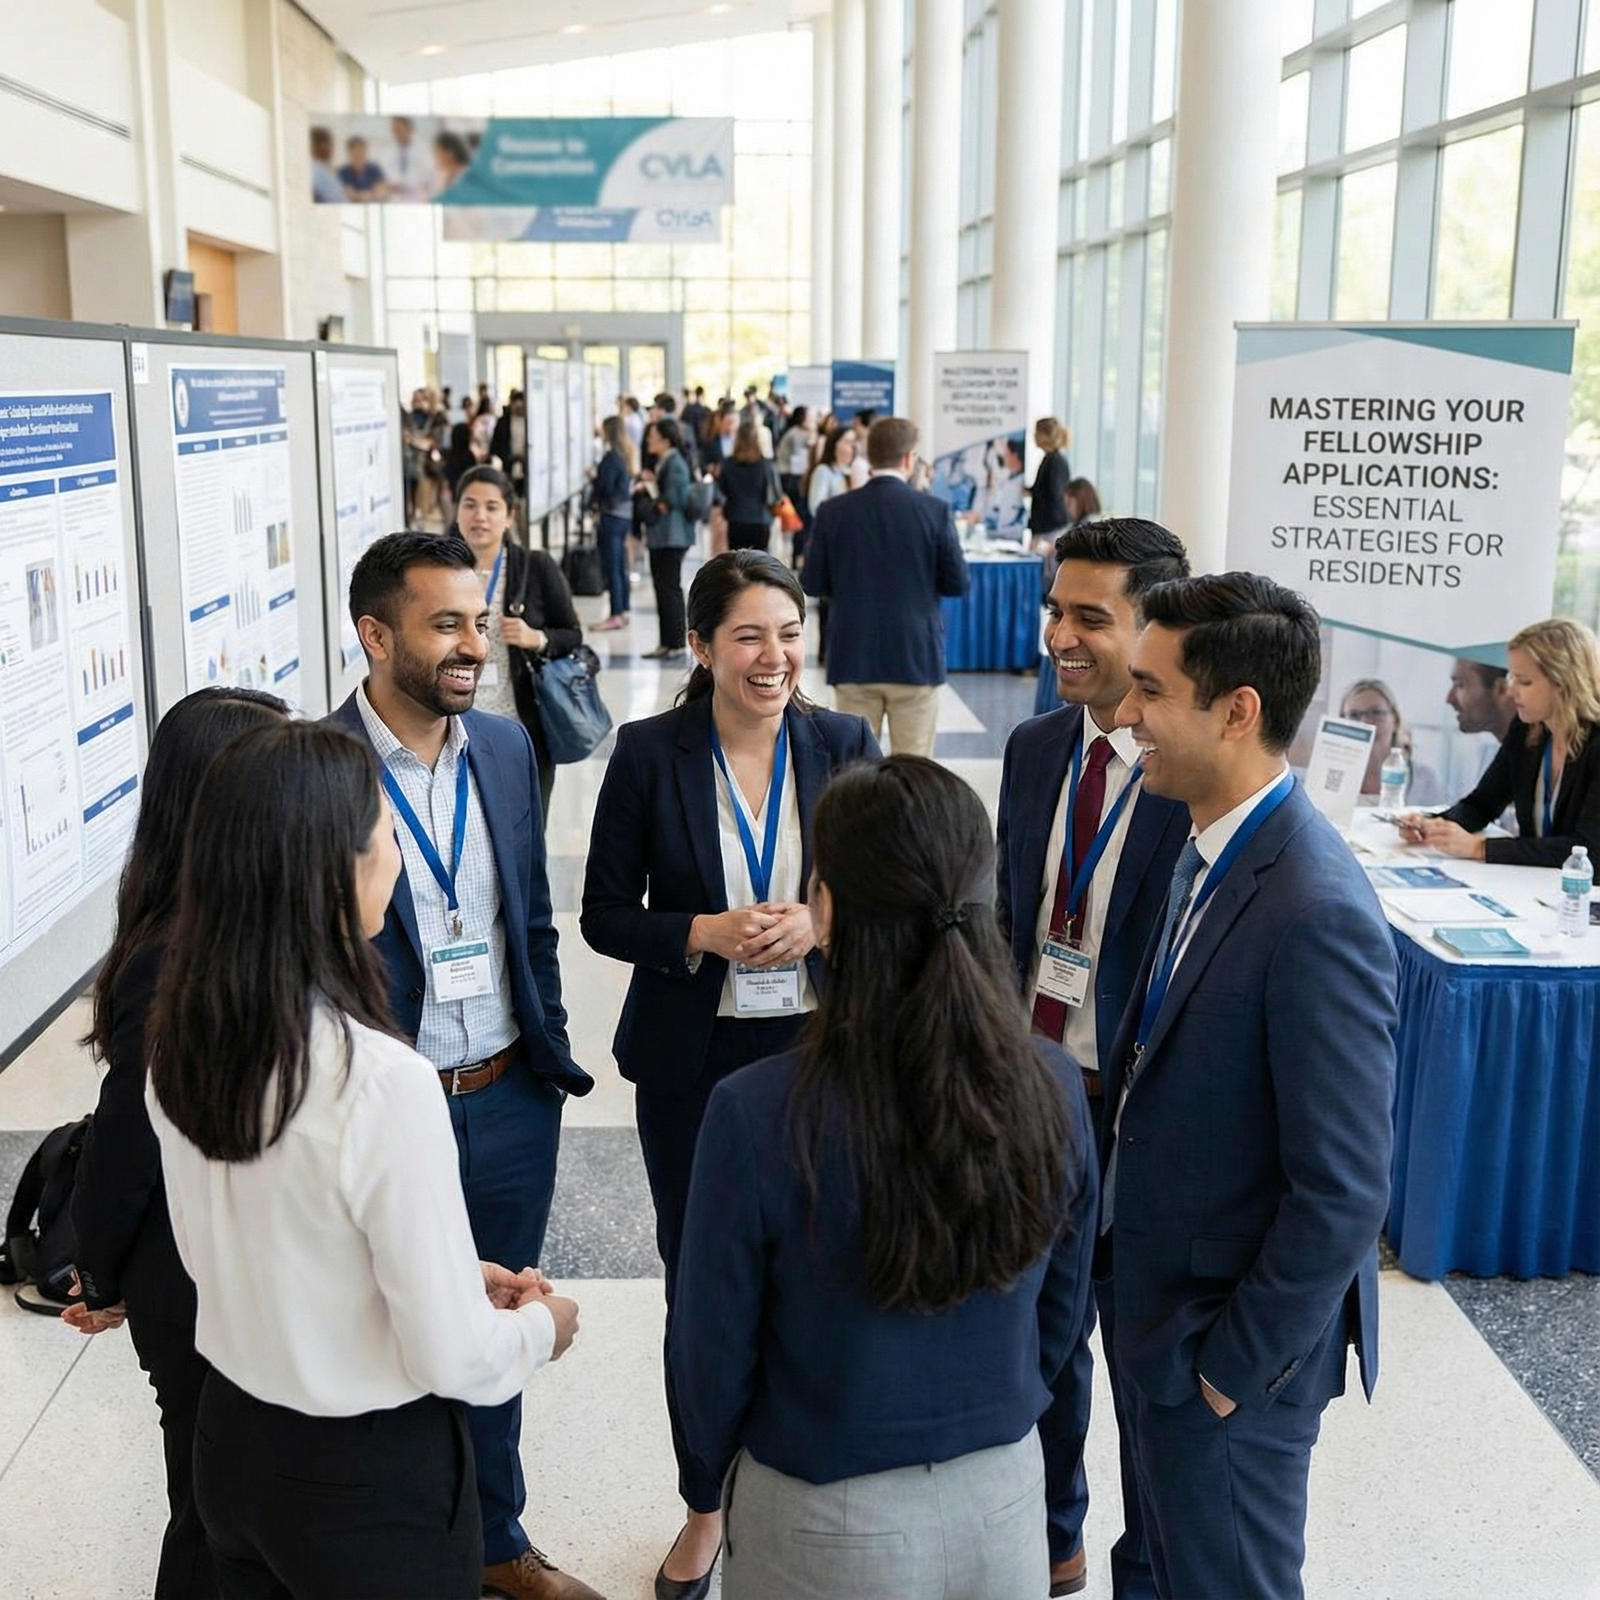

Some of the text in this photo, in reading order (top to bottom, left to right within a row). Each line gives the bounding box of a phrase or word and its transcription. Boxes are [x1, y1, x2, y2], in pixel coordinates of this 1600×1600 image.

[639, 152, 723, 179] CVLA
[1269, 397, 1525, 422] MASTERING YOUR
[1303, 430, 1483, 455] FELLOWSHIP
[1282, 462, 1499, 490] APPLICATIONS:
[1313, 495, 1463, 522] ESSENTIAL
[1271, 525, 1504, 557] STRATEGIES FOR
[1308, 559, 1462, 588] RESIDENTS
